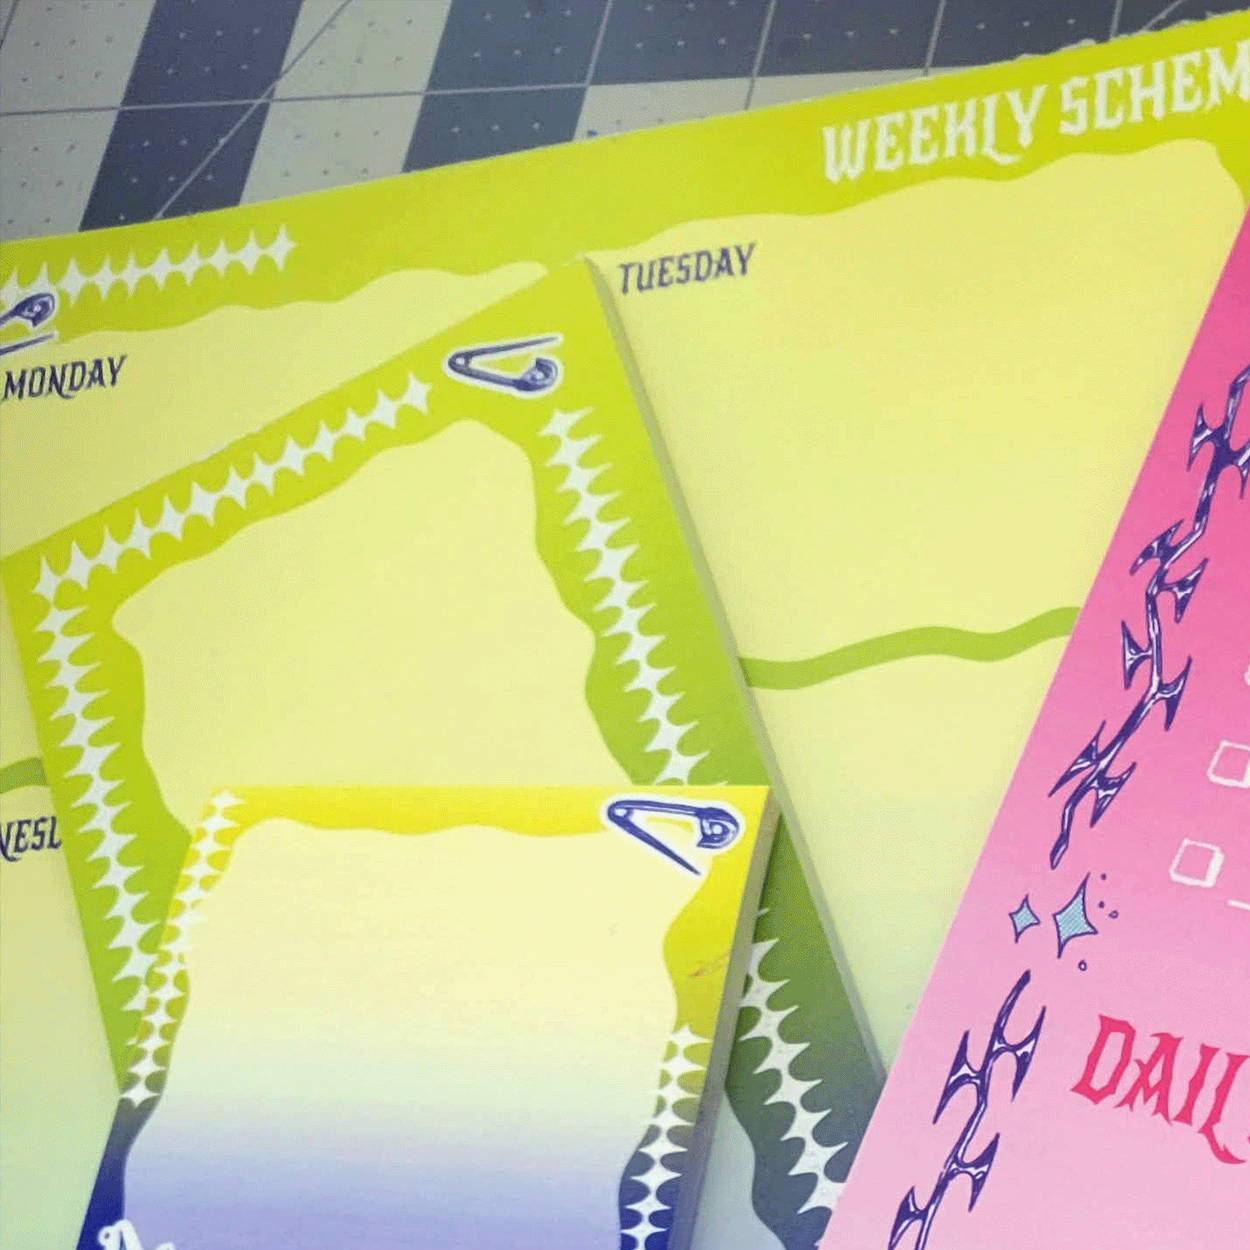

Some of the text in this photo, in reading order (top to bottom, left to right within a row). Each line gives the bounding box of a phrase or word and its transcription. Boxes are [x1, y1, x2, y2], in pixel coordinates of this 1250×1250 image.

[822, 84, 1048, 184] WEEKLY
[618, 241, 757, 295] TUESDAY
[2, 354, 127, 400] MONDAY
